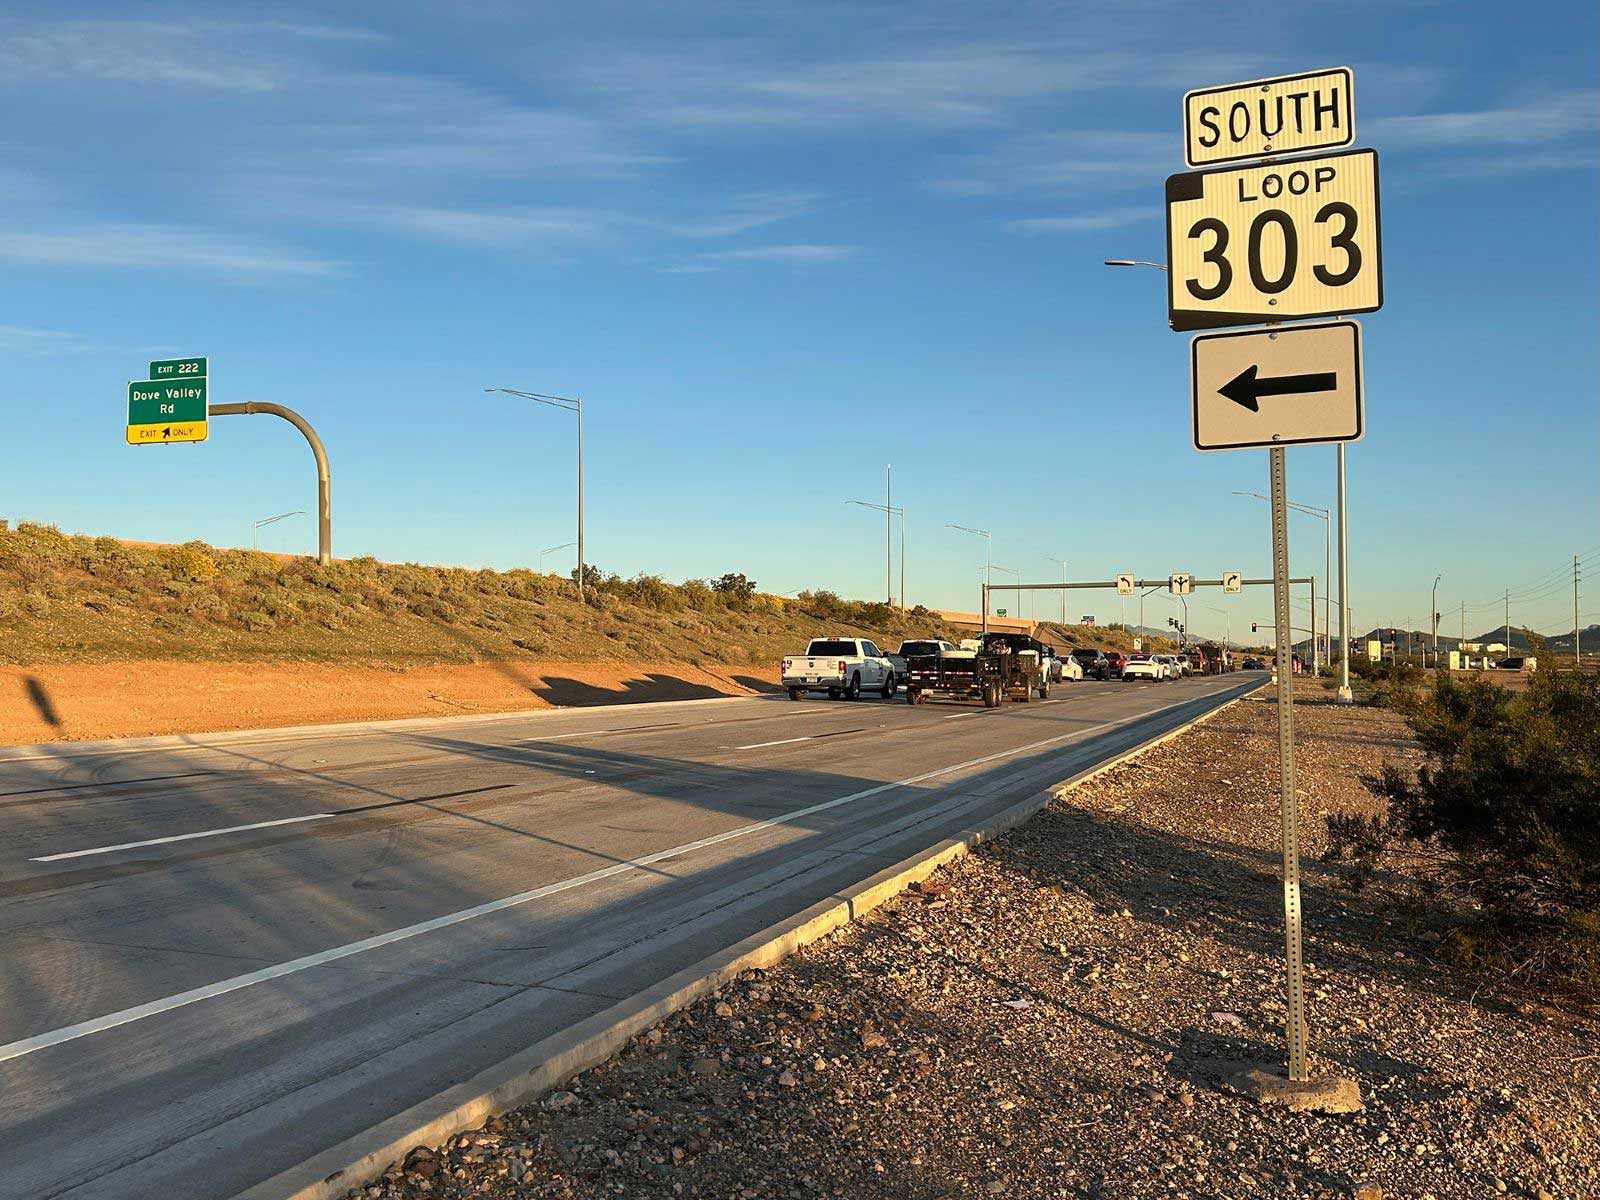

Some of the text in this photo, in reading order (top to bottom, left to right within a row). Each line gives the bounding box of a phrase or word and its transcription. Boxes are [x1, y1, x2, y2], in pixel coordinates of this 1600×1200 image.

[1198, 87, 1340, 148] SOUTH
[1238, 166, 1337, 203] LOOP
[1185, 201, 1363, 301] 303
[157, 363, 199, 374] EXIT 222
[133, 388, 202, 401] Dove Valley
[160, 404, 175, 414] Rd
[140, 428, 194, 438] EXIT ONLY
